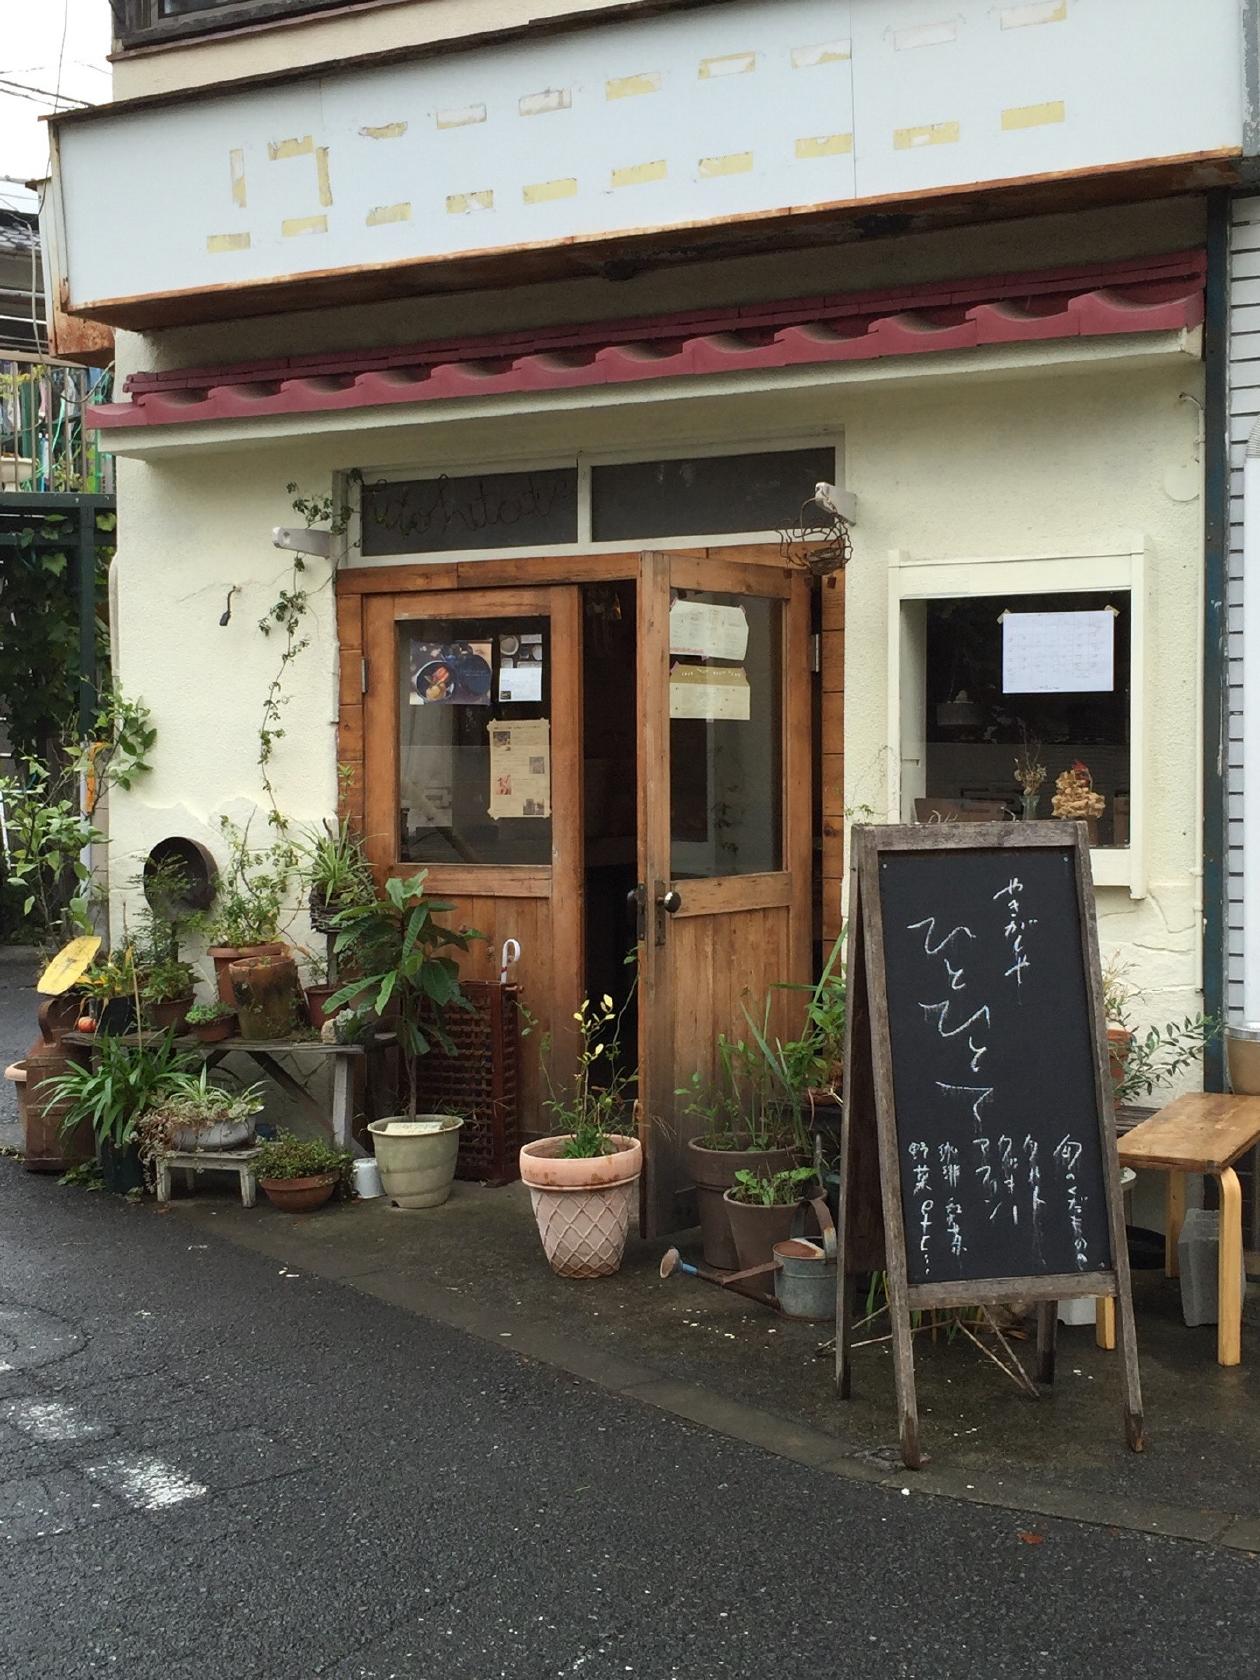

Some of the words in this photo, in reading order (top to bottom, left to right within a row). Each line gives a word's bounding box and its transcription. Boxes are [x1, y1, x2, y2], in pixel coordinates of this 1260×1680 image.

[993, 877, 1039, 985] やきがしや
[906, 916, 994, 1123] ひとひとて
[972, 1138, 1002, 1221] マフィン
[998, 1134, 1019, 1225] クッキー
[1023, 1133, 1046, 1214] タルト
